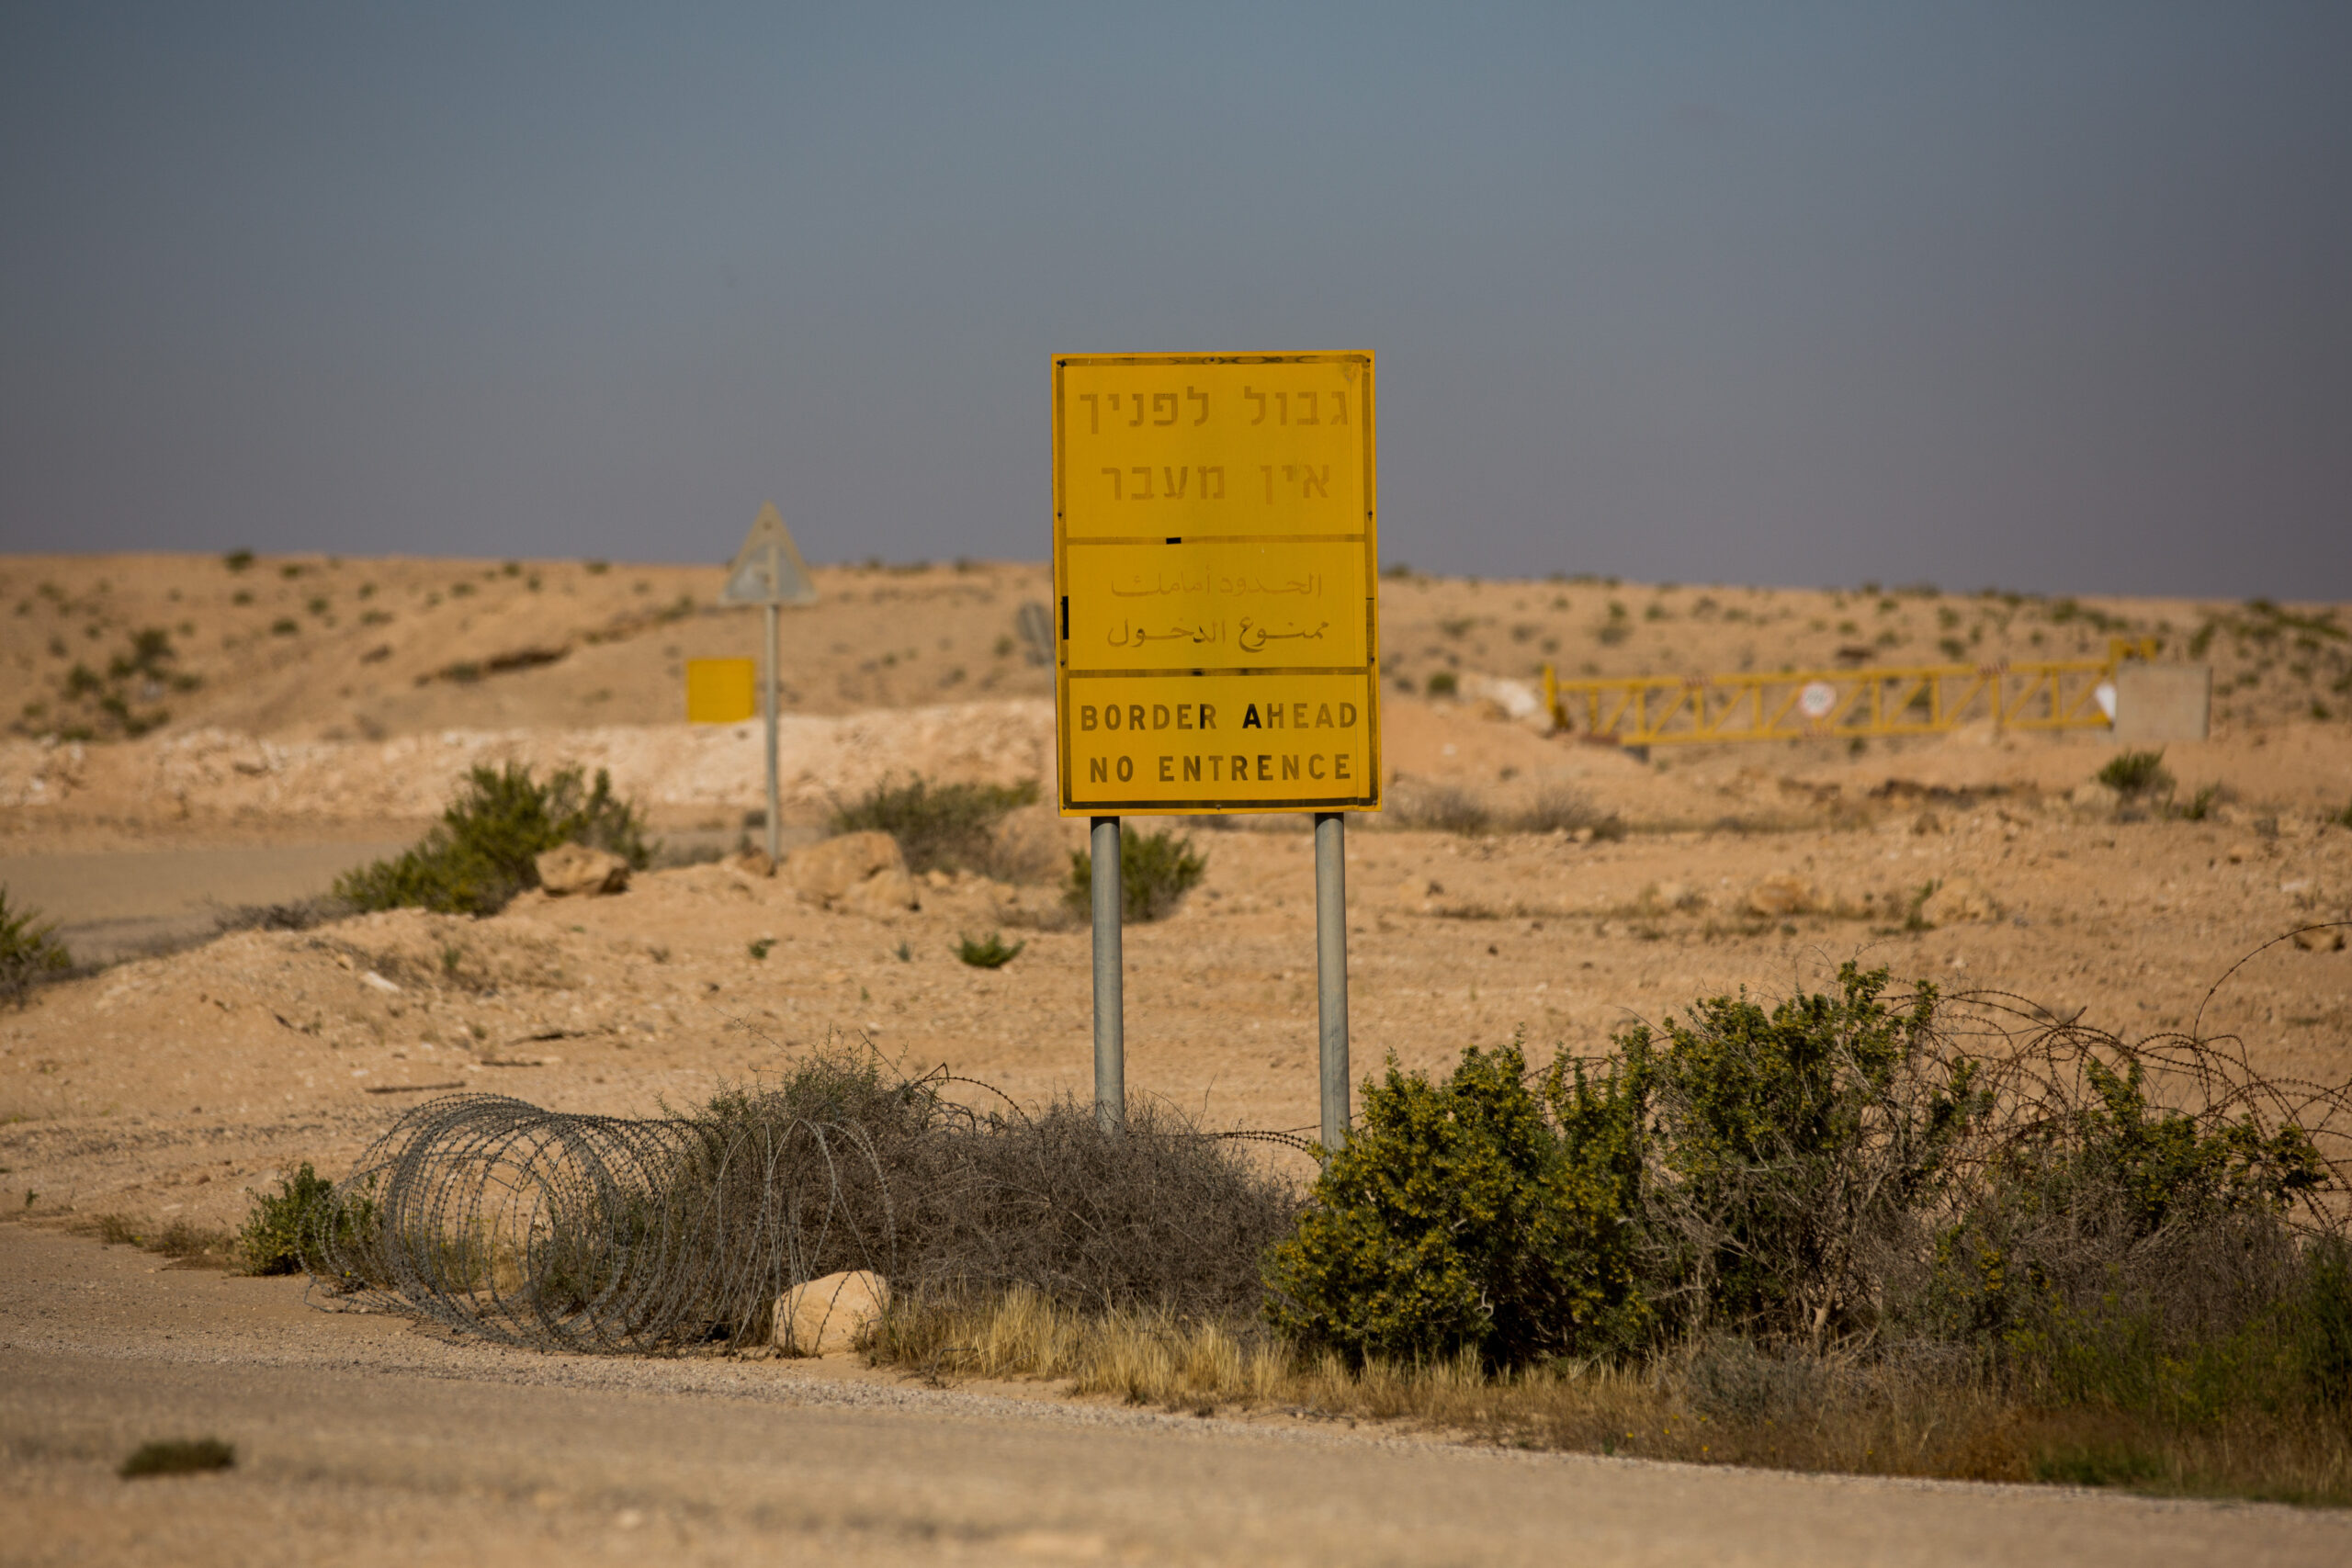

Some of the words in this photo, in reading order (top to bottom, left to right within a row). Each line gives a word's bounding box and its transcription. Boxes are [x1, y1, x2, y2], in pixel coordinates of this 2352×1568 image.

[1080, 386, 1210, 434] לפניך
[1244, 385, 1349, 426] גבול
[1101, 465, 1227, 502] מעבר
[1259, 464, 1330, 506] אין
[1110, 563, 1212, 598] أمامك
[1219, 571, 1323, 598] الحدود
[1106, 616, 1227, 648] الدخول
[1238, 615, 1330, 653] ممنوع
[1080, 703, 1218, 731] BORDER
[1242, 702, 1358, 729] AHEAD
[1090, 755, 1135, 783] NO
[1159, 753, 1351, 782] ENTRENCE
